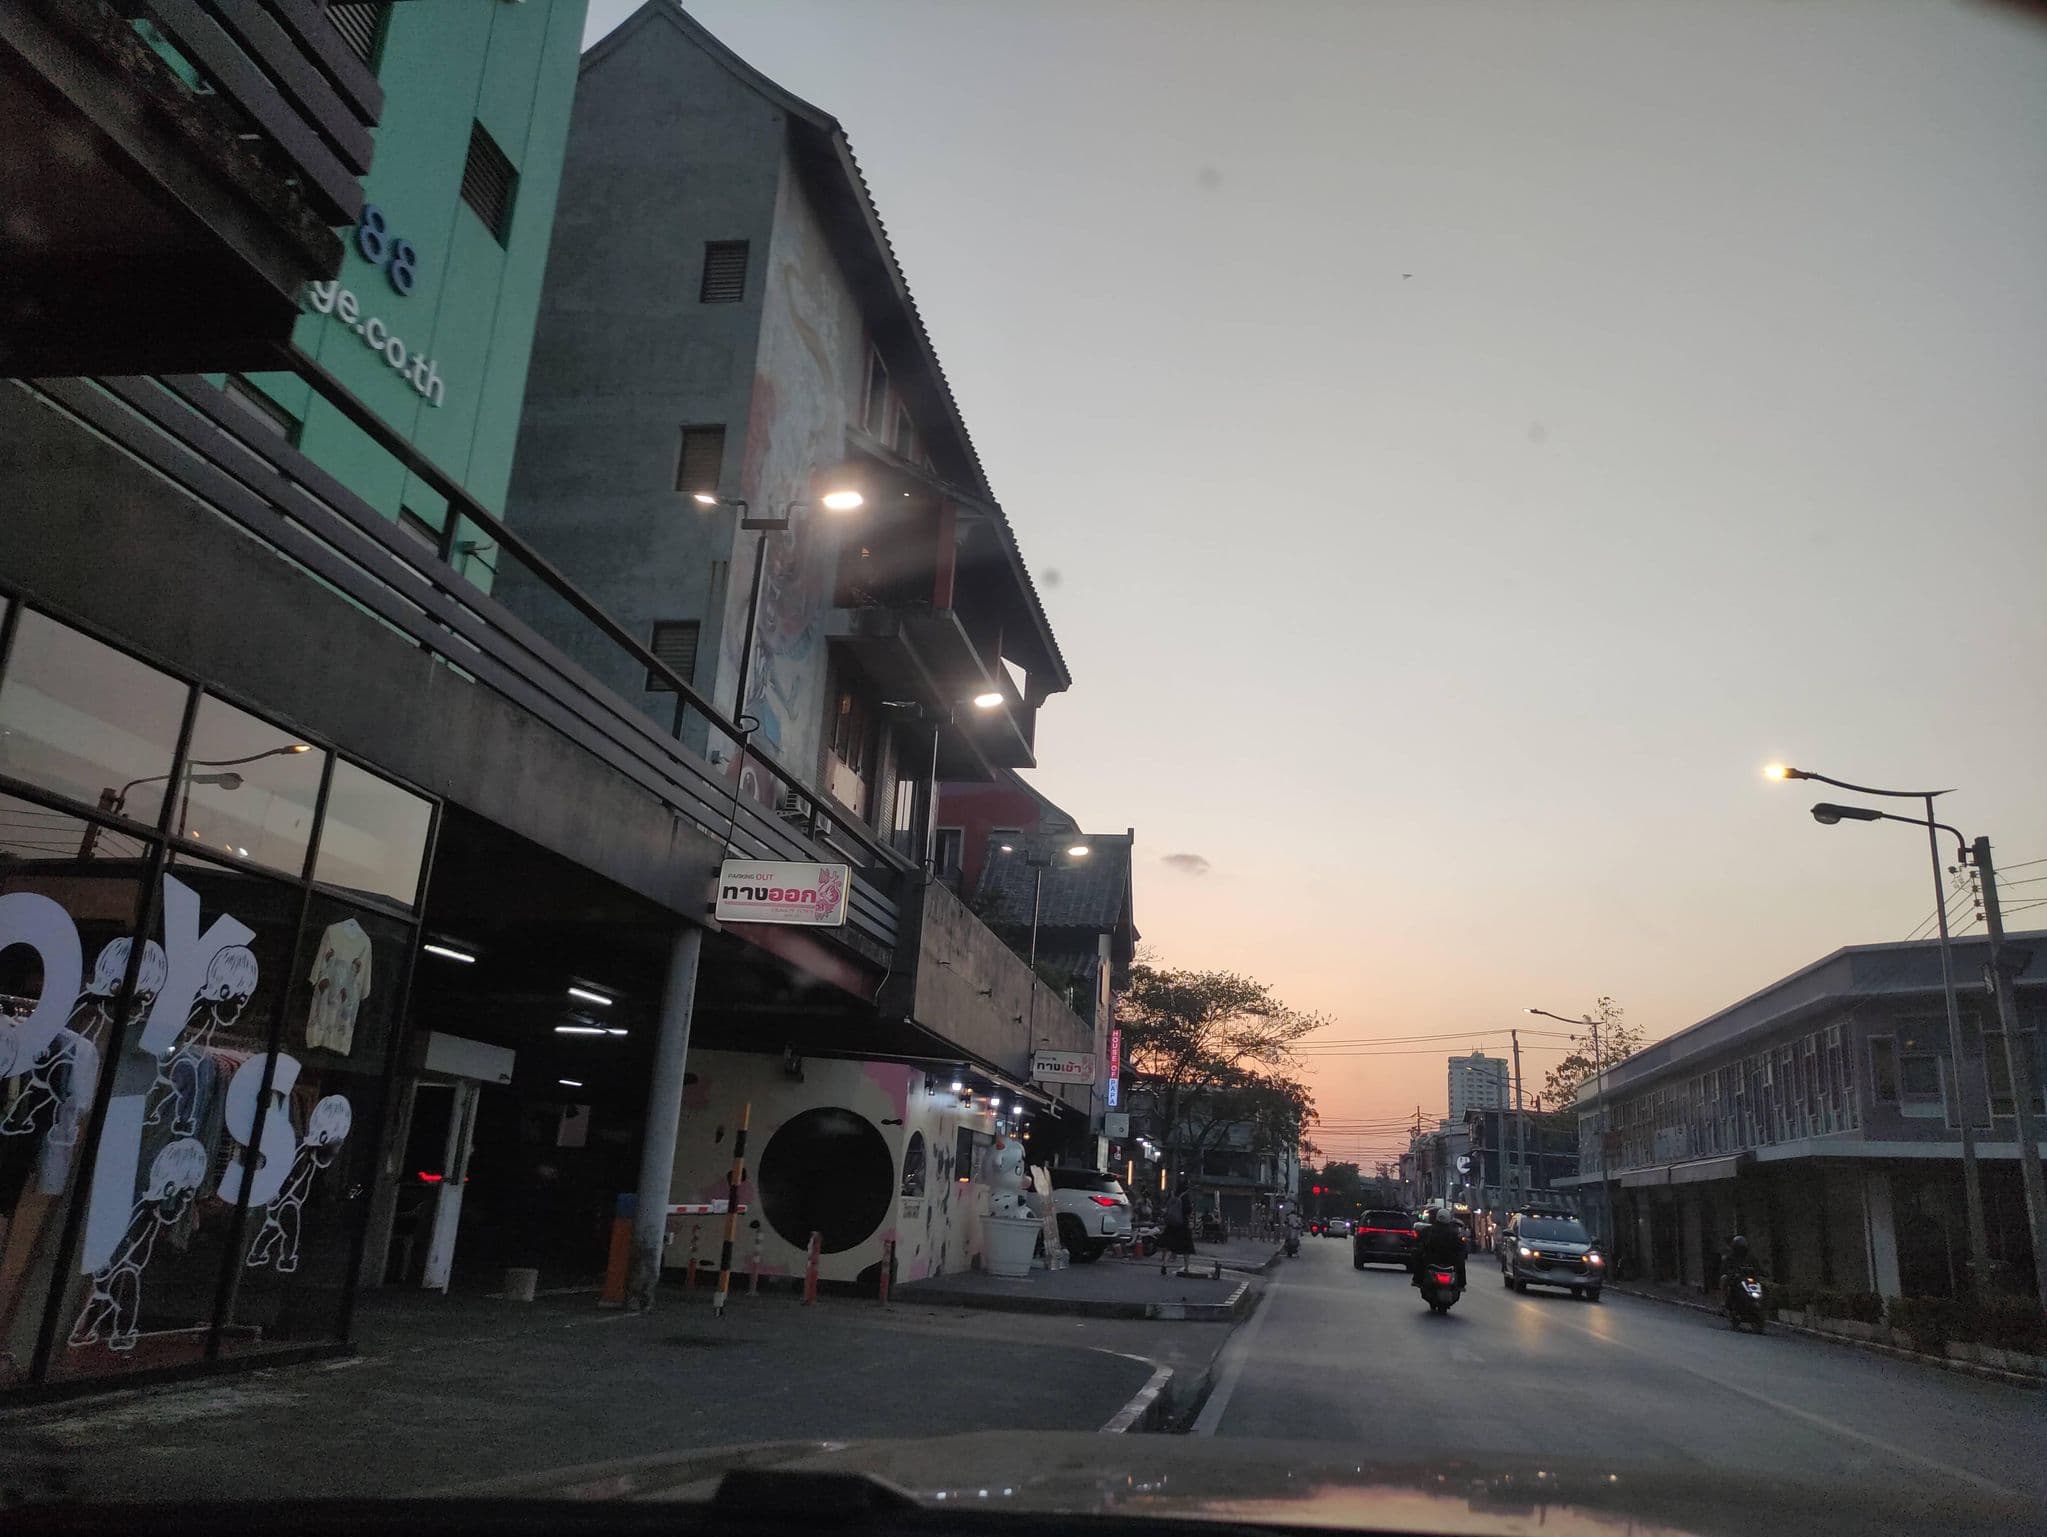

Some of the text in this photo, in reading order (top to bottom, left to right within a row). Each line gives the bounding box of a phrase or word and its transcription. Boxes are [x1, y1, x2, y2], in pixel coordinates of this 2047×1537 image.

[755, 873, 775, 881] OUT
[722, 886, 817, 903] ทางออก
[1037, 1061, 1082, 1073] ทางเข้า
[1109, 1080, 1117, 1105] PAPA
